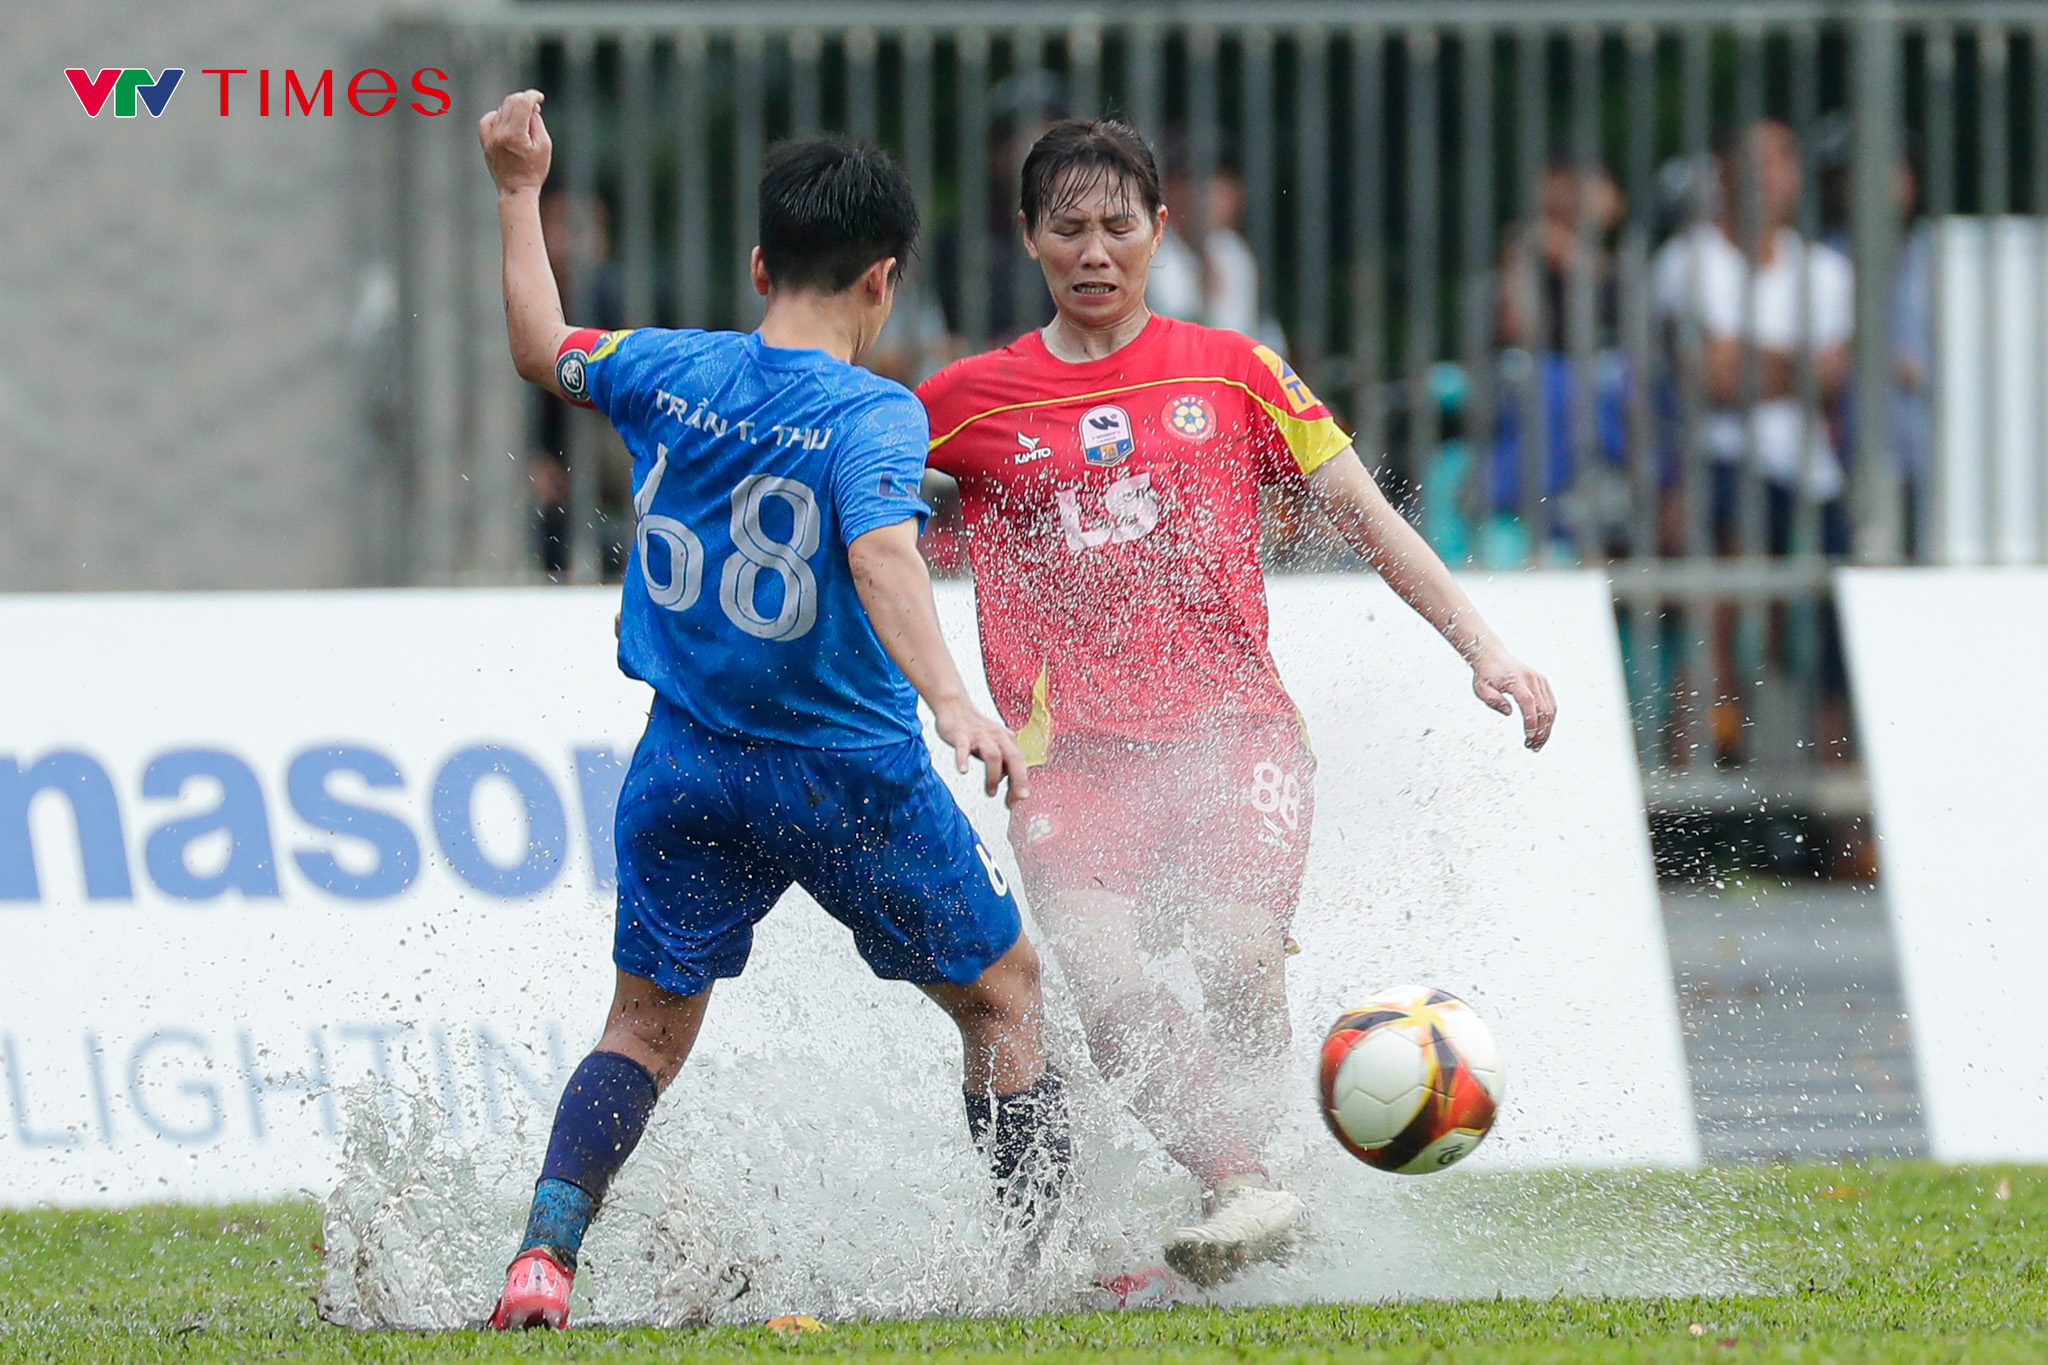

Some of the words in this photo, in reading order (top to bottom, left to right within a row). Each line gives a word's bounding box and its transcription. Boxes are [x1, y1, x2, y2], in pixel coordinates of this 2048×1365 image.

[655, 388, 729, 438] TRẦN
[737, 420, 758, 445] T.
[771, 424, 833, 450] THU
[1014, 446, 1052, 465] KAMITO
[633, 442, 821, 642] 68
[1056, 473, 1158, 550] LS
[3, 1023, 602, 1146] LIGHTIN
